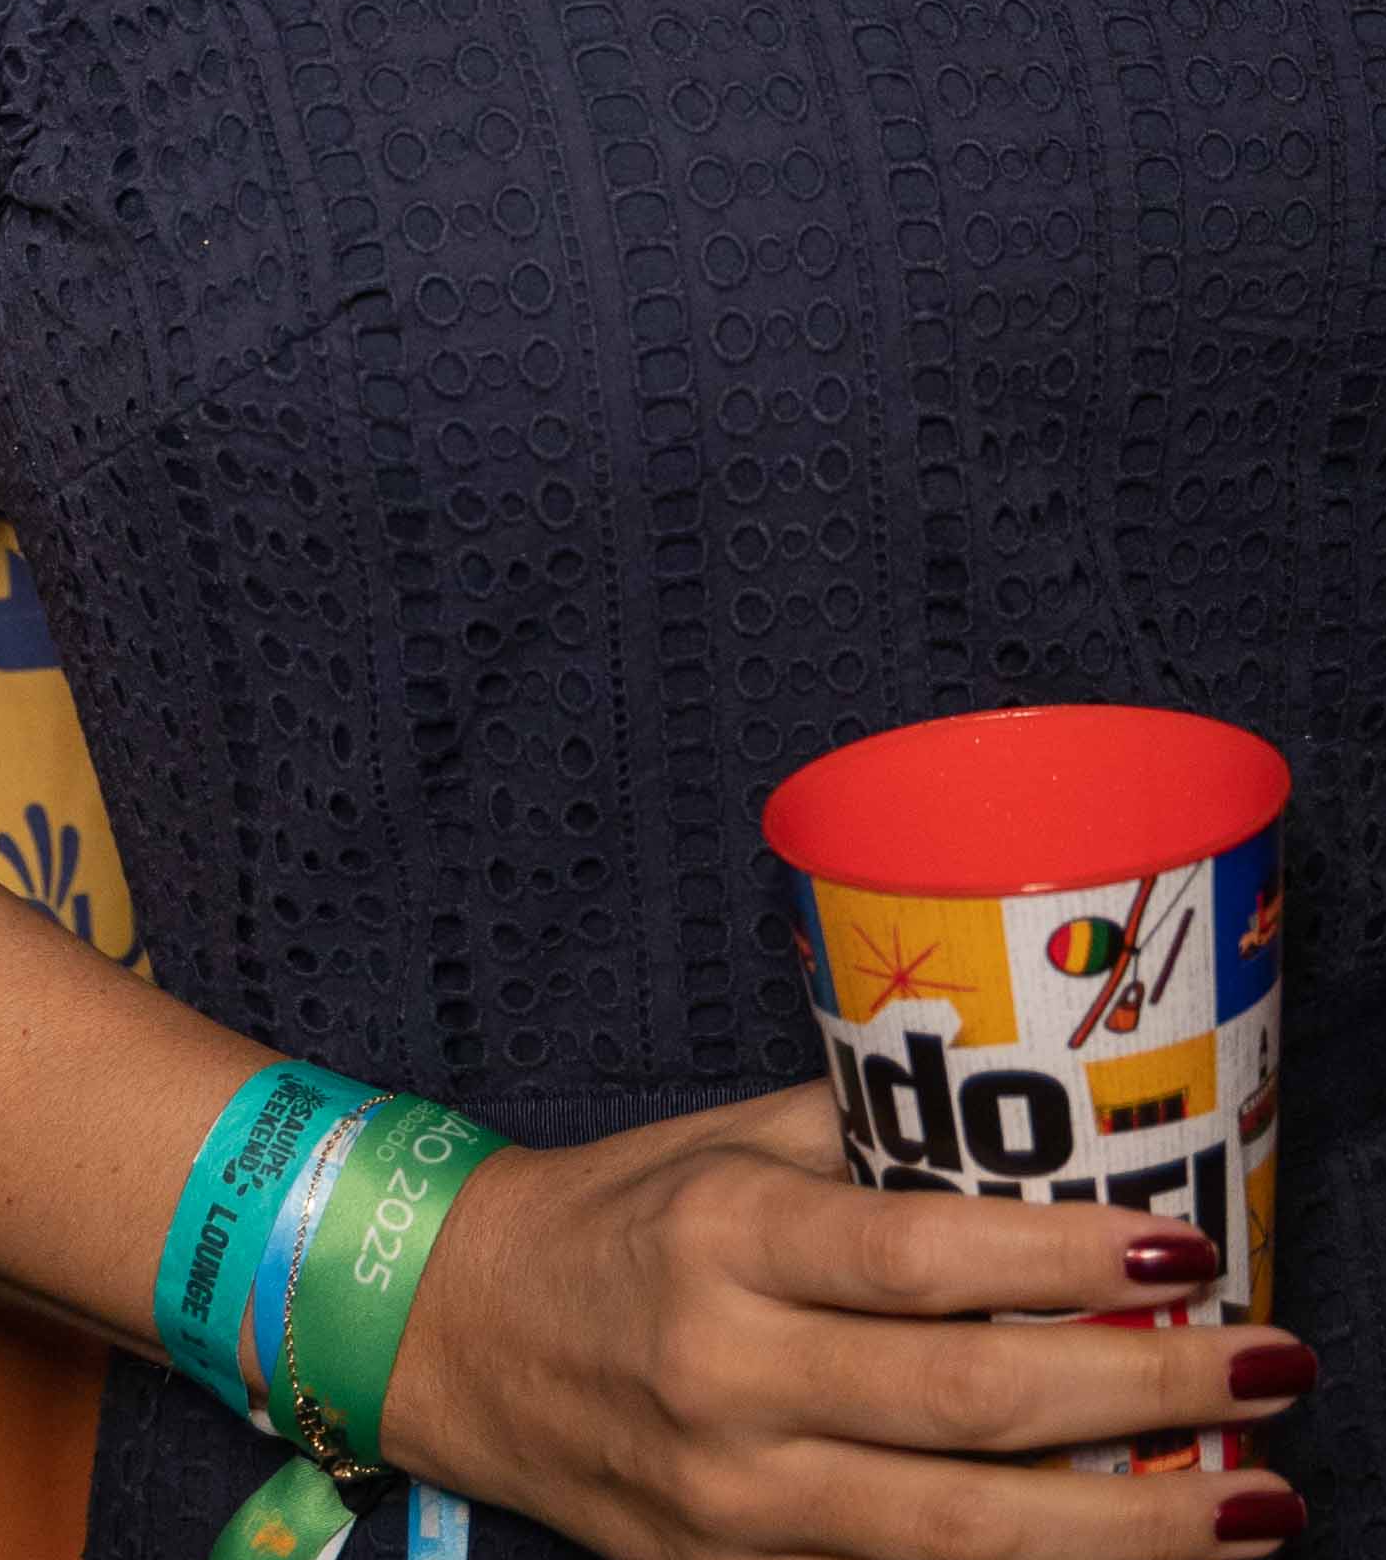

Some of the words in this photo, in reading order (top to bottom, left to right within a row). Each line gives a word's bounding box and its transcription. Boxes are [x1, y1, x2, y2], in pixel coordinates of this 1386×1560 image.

[237, 1079, 302, 1177] WEEKEND
[181, 1201, 239, 1325] LOUNGE
[354, 1168, 428, 1293] 2025
